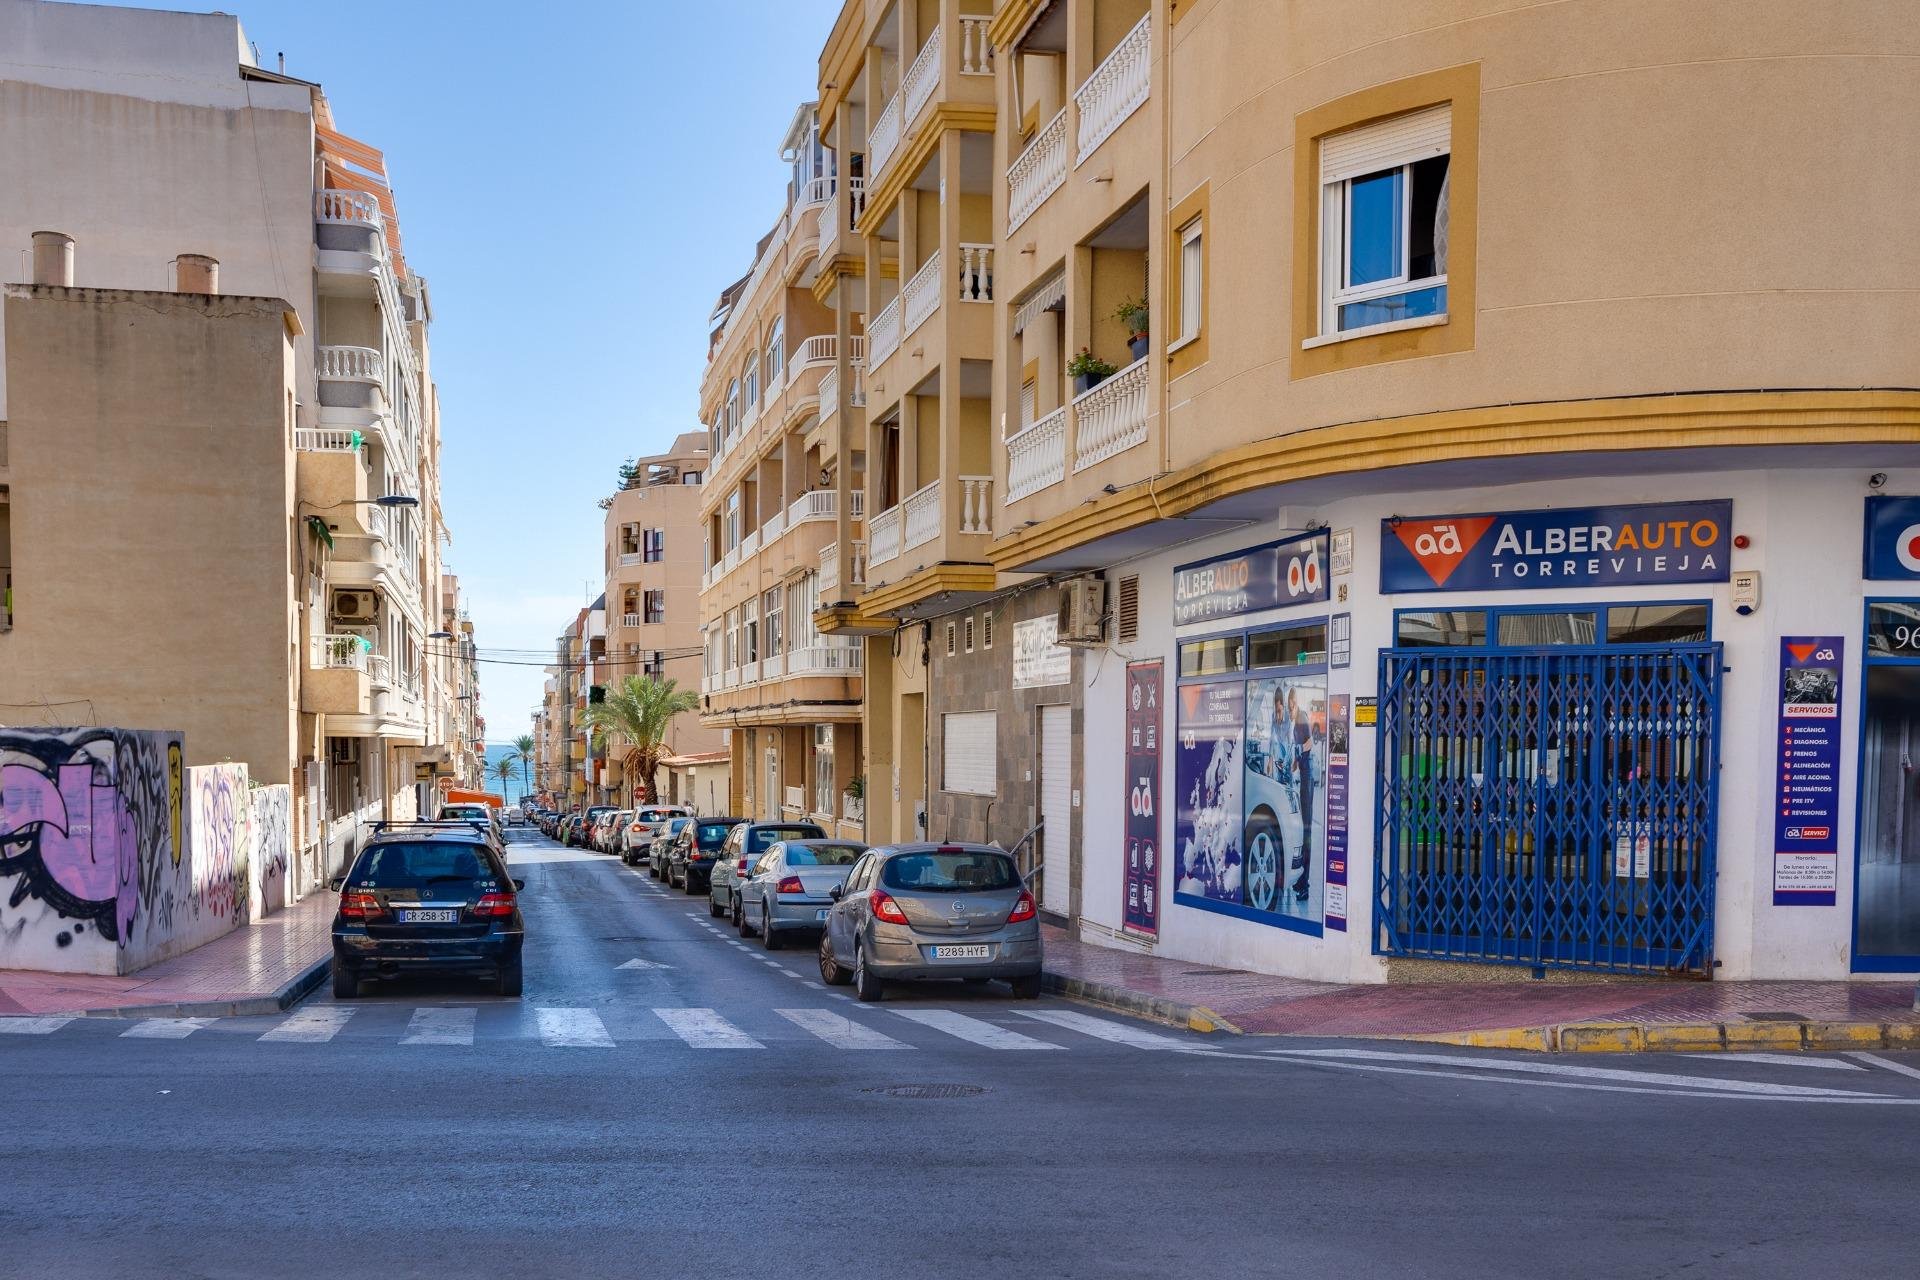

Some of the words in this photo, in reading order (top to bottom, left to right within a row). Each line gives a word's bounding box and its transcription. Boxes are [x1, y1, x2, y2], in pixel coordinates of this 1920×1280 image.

[1493, 520, 1719, 555] ALBERAUTO
[1491, 554, 1717, 578] TORREVIEJA
[1177, 559, 1249, 600] ALBERAUTO
[1338, 584, 1348, 602] 49
[1176, 593, 1248, 621] TORREVIEJA
[1787, 706, 1834, 714] SERVICIOS
[938, 947, 965, 957] 3289
[967, 946, 986, 957] HYF
